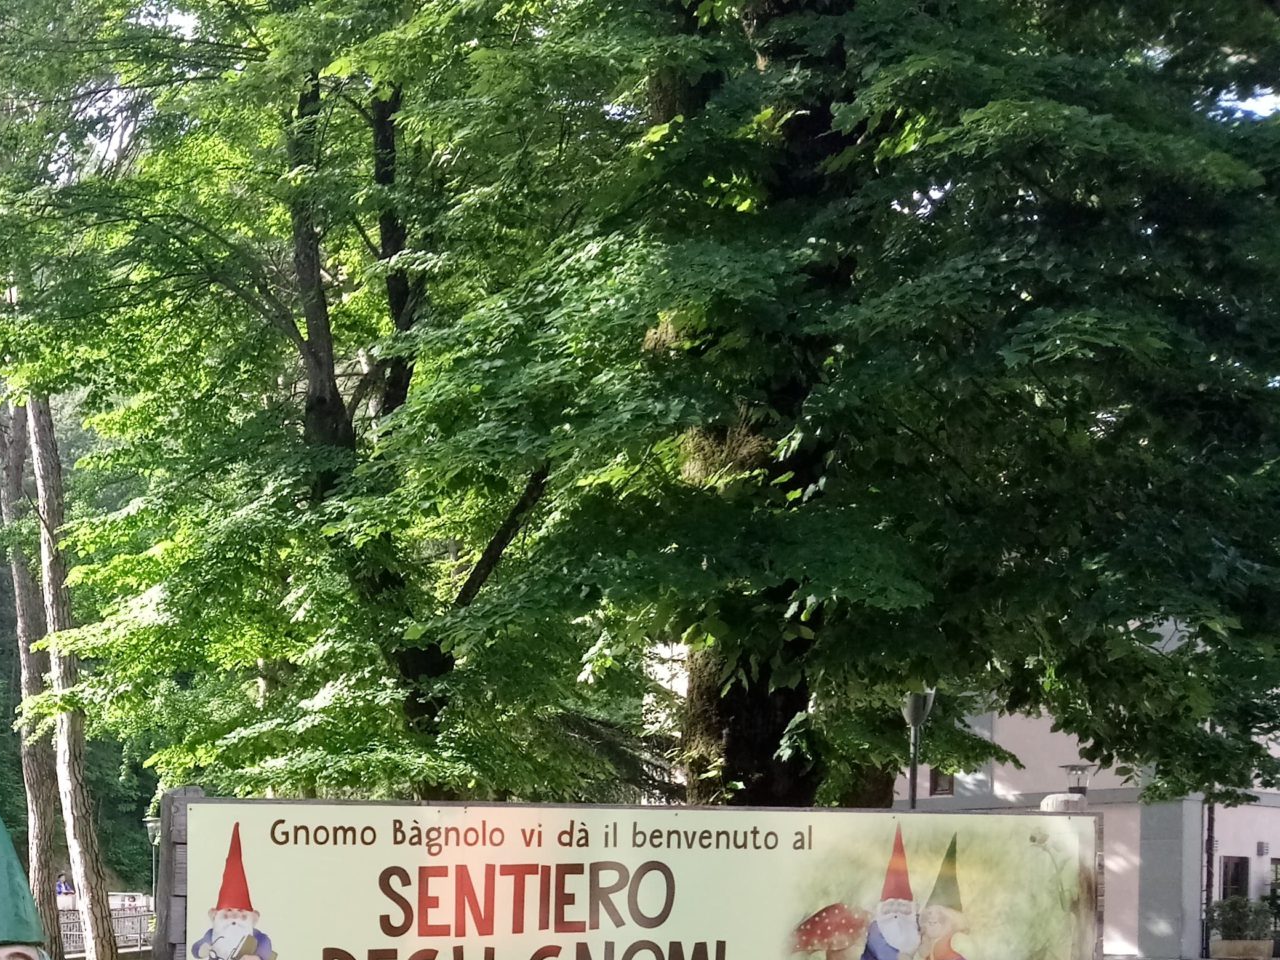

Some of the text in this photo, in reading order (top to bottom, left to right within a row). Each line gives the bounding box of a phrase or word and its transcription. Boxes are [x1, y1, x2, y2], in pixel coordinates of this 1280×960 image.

[270, 819, 812, 856] Gnomo Bàgnolo vi dà il benvenuto al
[379, 860, 675, 937] SENTIERO
